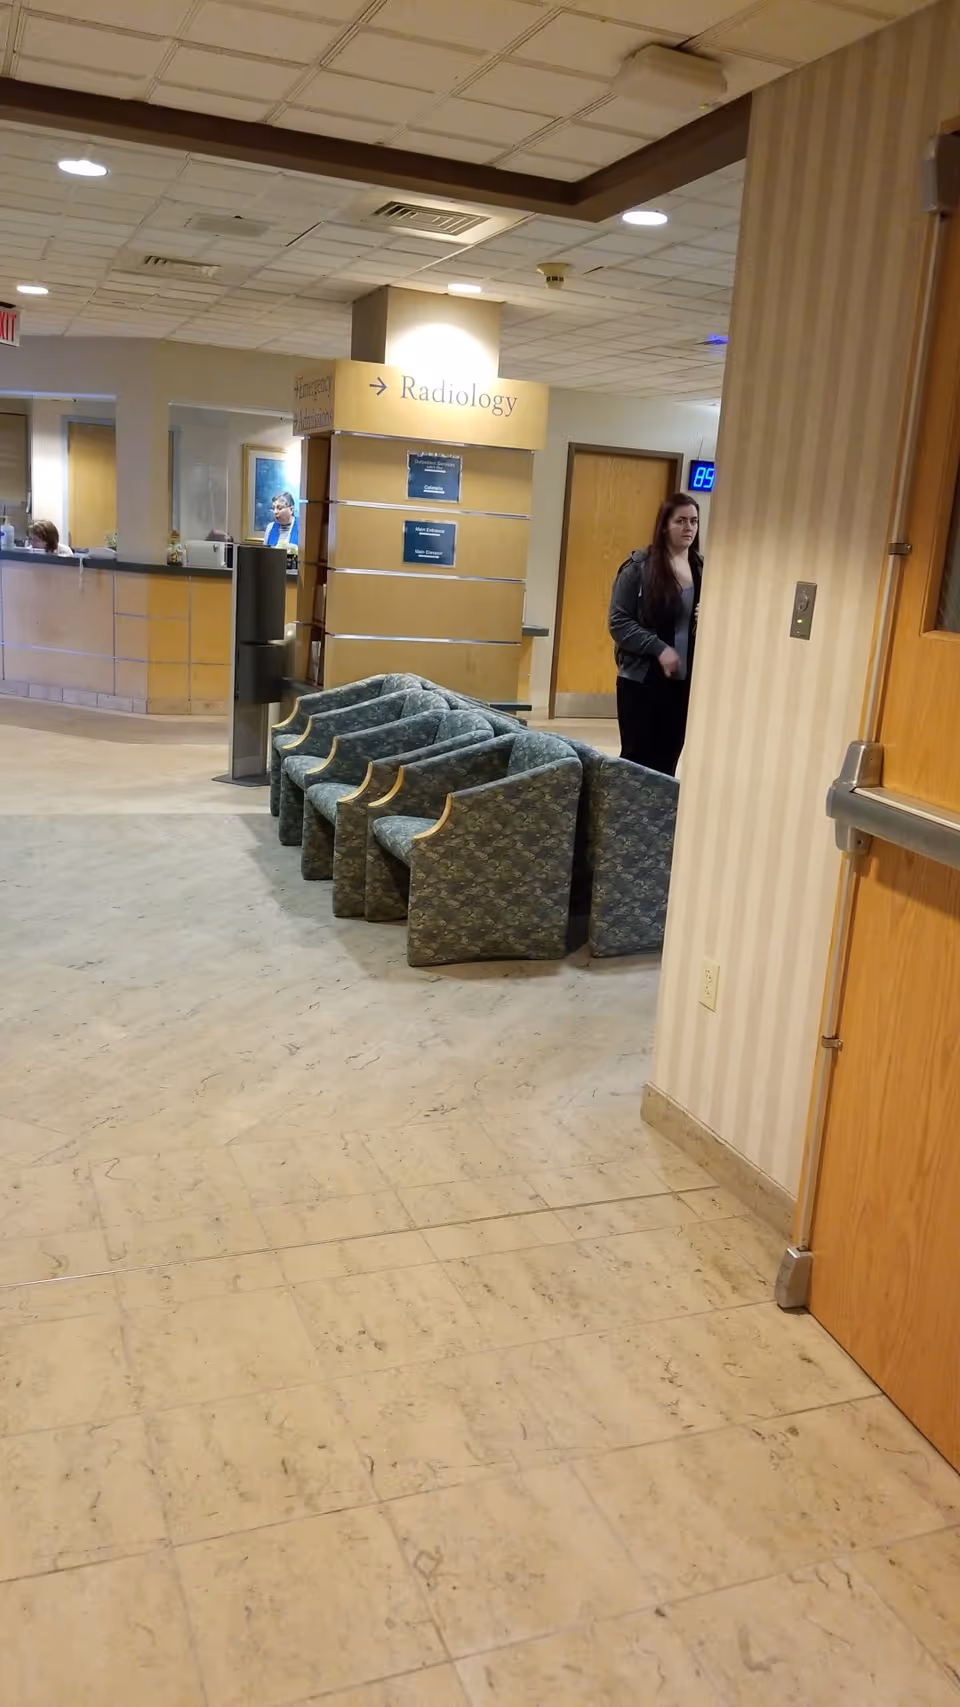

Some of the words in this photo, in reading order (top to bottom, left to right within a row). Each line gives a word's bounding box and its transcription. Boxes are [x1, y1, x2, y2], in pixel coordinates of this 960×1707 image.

[0, 311, 16, 342] XIT
[299, 376, 332, 402] Emergency
[400, 374, 518, 417] Radiology
